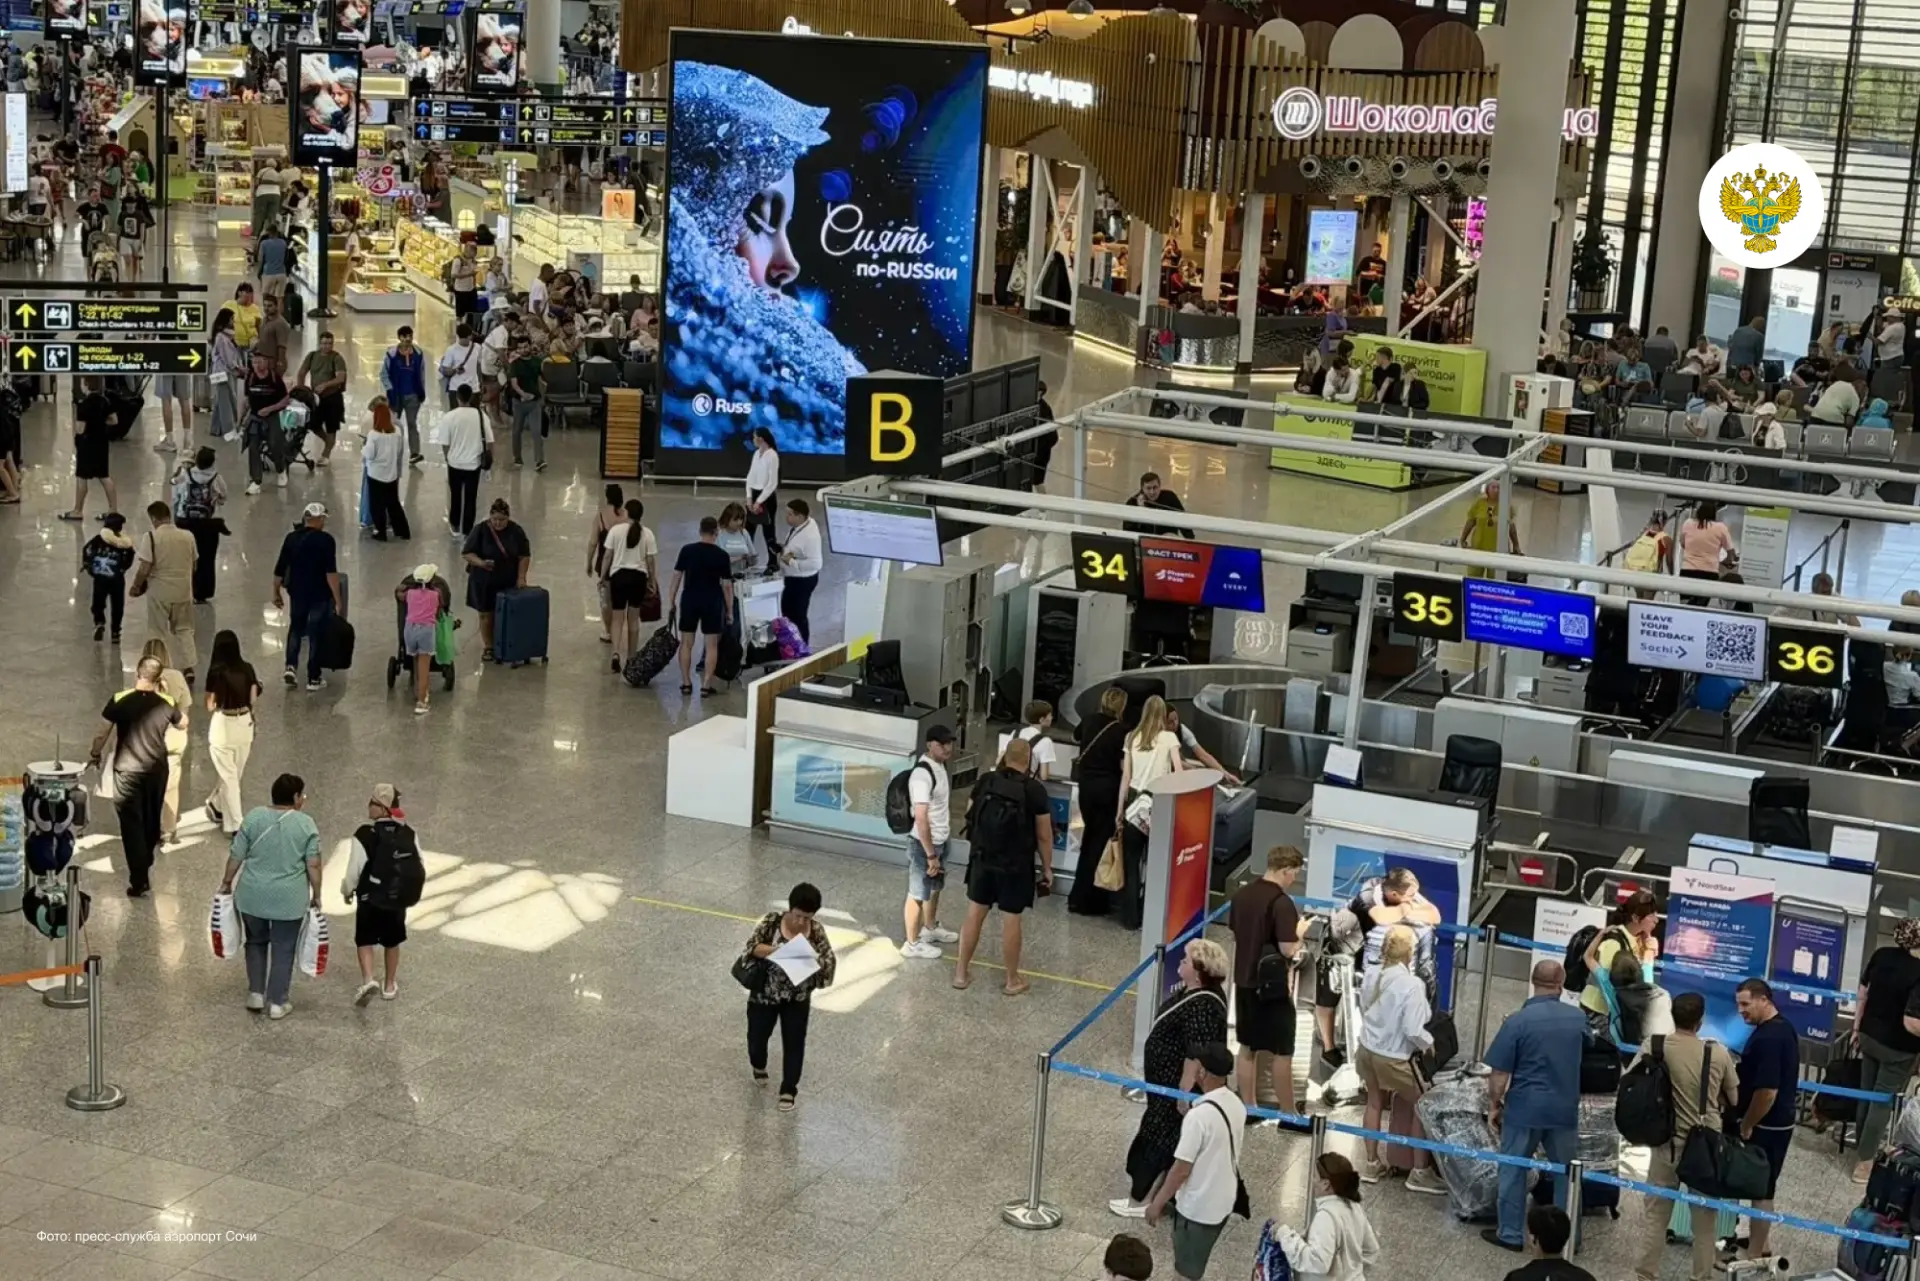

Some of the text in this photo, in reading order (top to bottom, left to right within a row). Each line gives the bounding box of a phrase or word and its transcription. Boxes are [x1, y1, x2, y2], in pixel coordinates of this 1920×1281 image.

[820, 202, 935, 256] Сиять
[856, 261, 958, 281] по-RUSSки
[715, 398, 752, 414] Russ
[1316, 456, 1347, 470] ЗДЕСЬ
[1148, 549, 1194, 560] ФАСТ ТРЕК
[1081, 550, 1128, 582] 34
[1402, 591, 1454, 626] 35
[1640, 613, 1673, 623] LEAVE
[1640, 621, 1669, 630] YOUR
[1640, 629, 1694, 642] FEEDBACK
[1640, 642, 1674, 654] Sochi
[1778, 642, 1835, 674] 36
